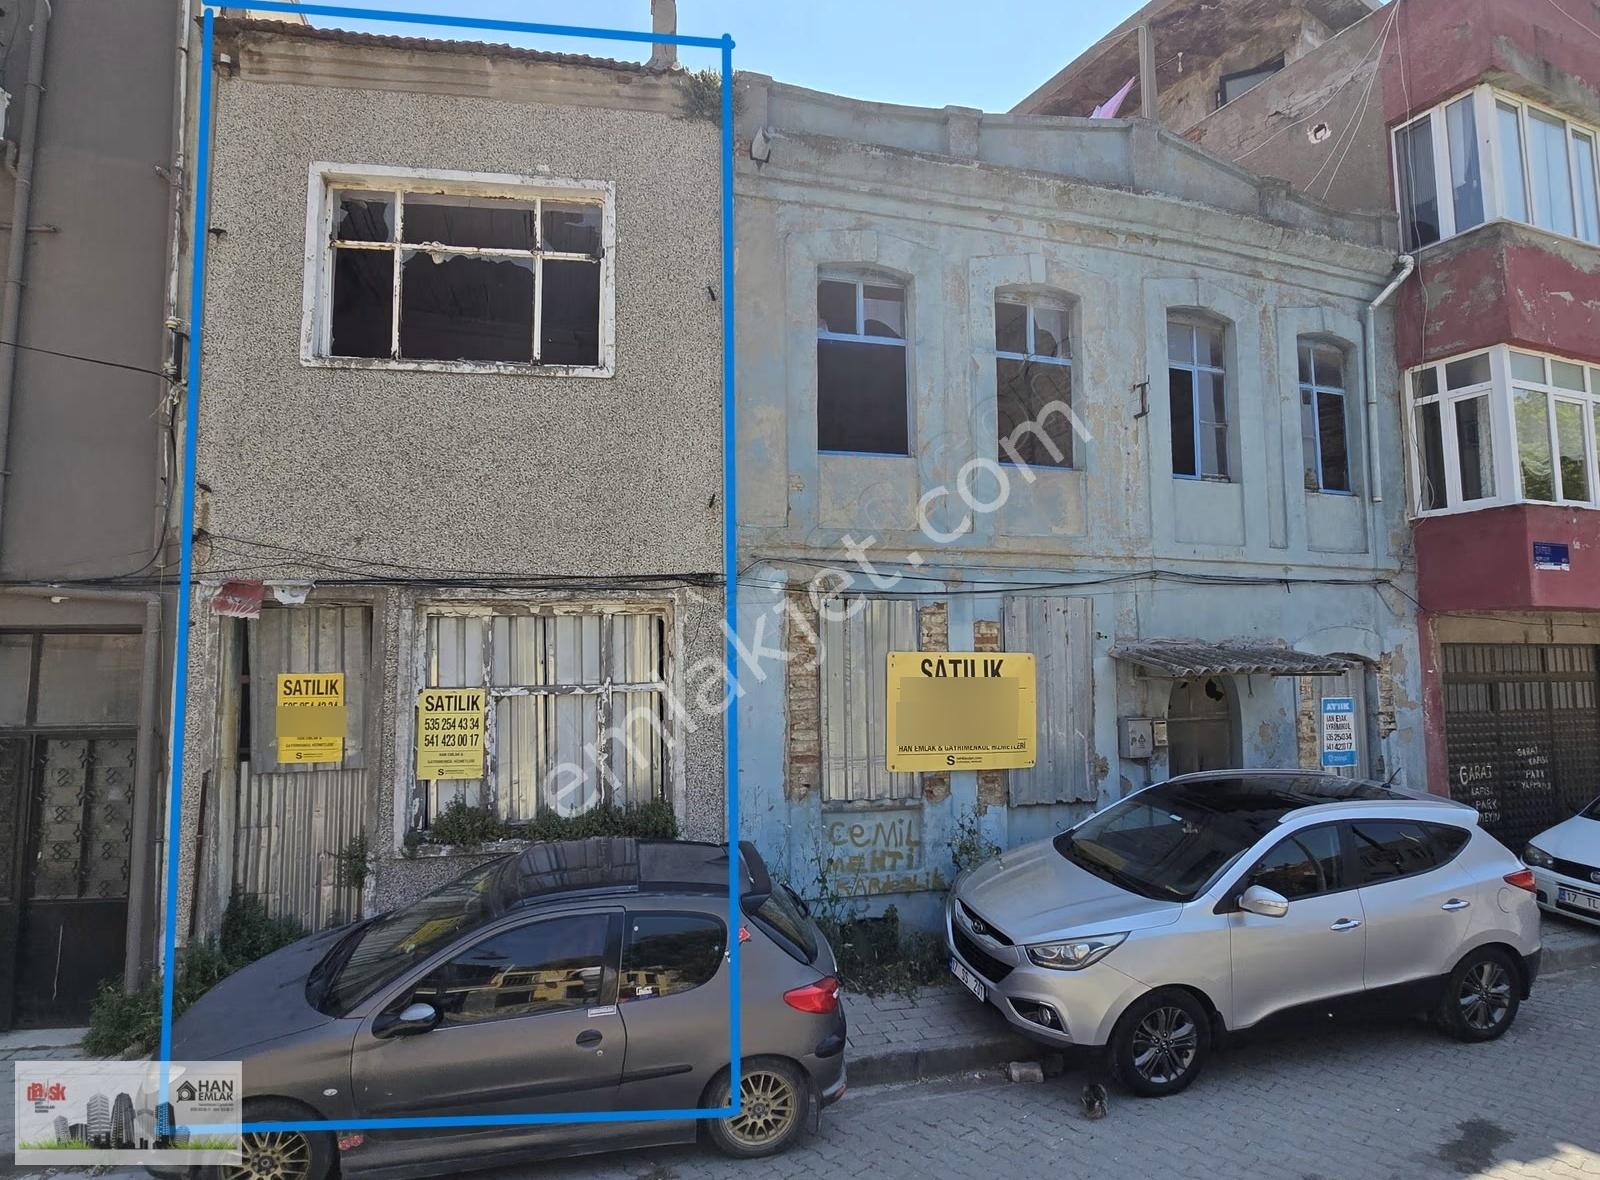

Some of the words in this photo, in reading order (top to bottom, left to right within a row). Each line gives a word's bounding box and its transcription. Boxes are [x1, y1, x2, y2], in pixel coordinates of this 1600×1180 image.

[283, 679, 339, 696] SATILIK
[425, 695, 481, 712] SATILIK
[424, 718, 440, 731] 535
[441, 717, 456, 731] 254
[458, 717, 468, 731] 43
[469, 717, 480, 730] 34
[424, 734, 439, 747] 541
[441, 733, 456, 747] 423
[457, 733, 468, 747] 00
[469, 733, 480, 747] 17
[1460, 763, 1492, 785] GARAJ
[1567, 892, 1577, 903] 17
